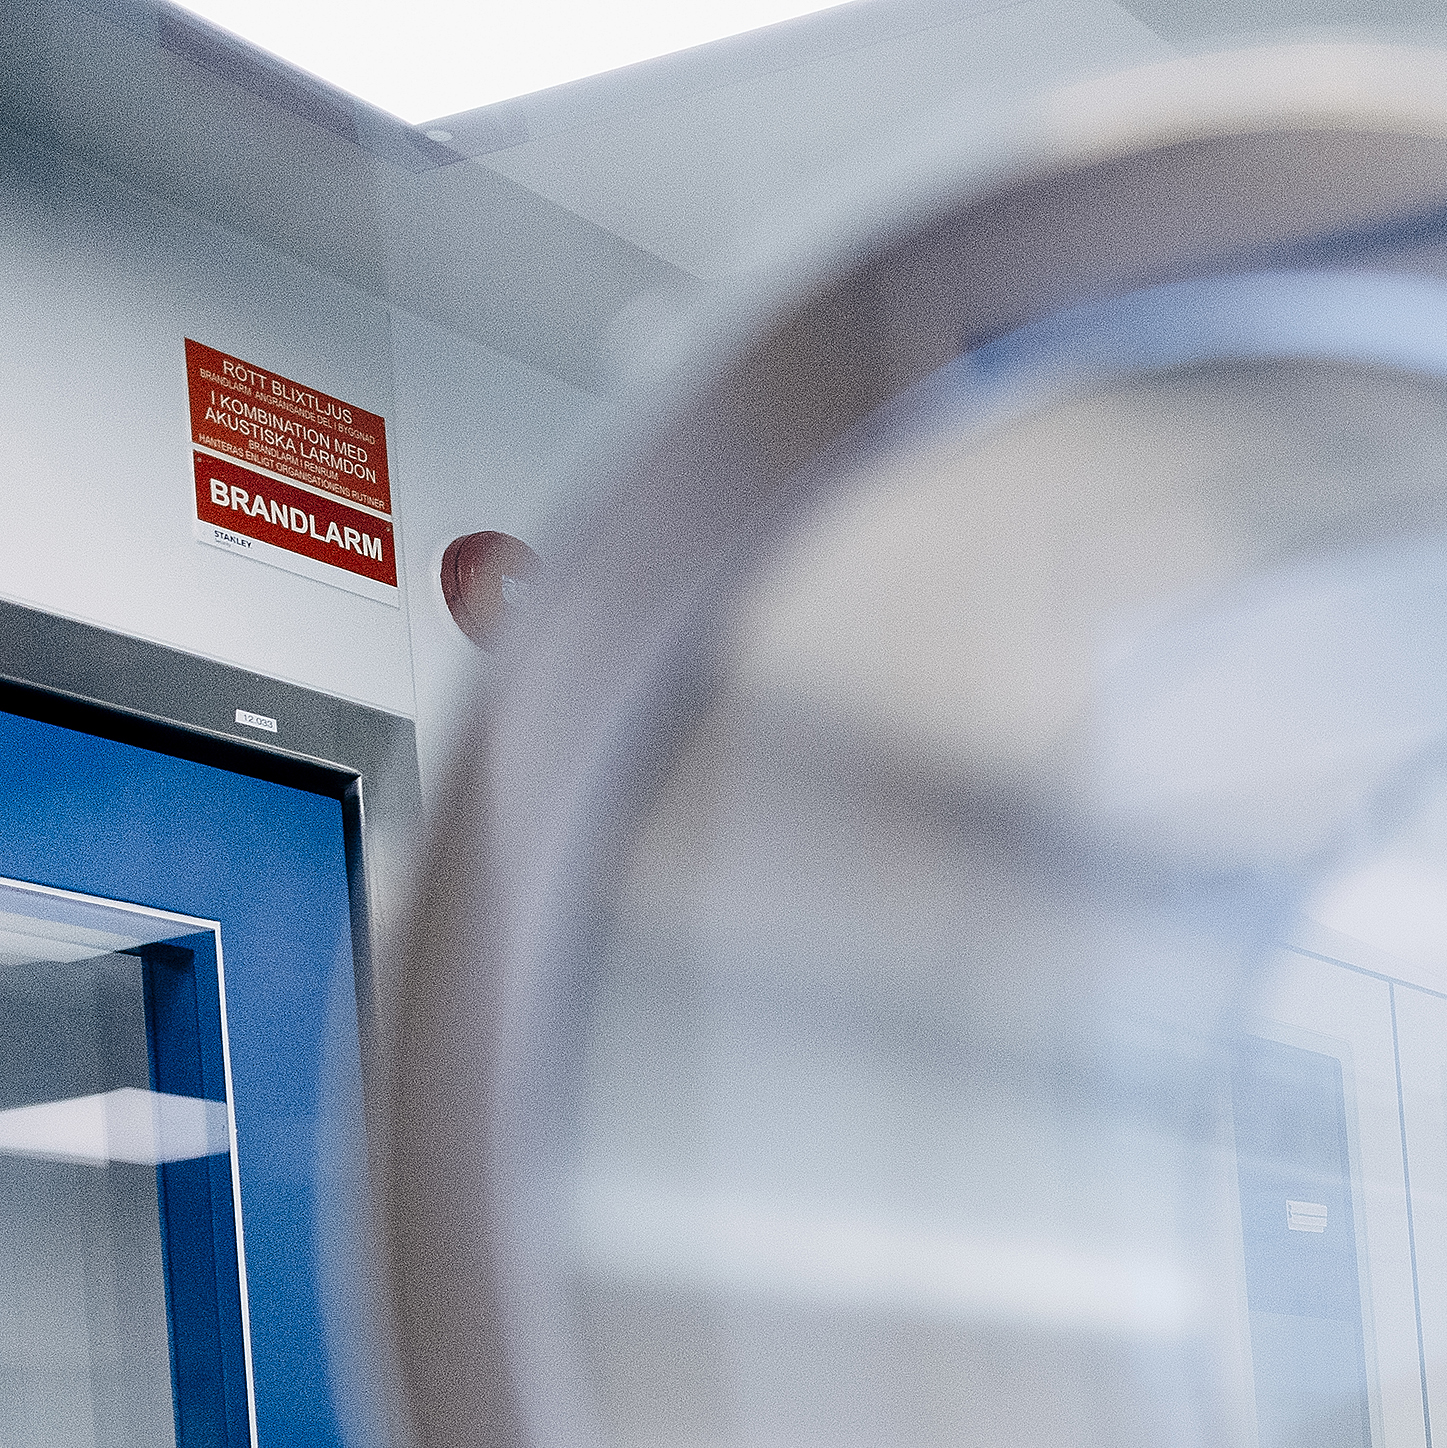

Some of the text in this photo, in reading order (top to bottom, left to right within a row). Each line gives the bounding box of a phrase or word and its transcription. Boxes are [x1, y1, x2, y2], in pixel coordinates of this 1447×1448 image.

[200, 368, 252, 396] BRANDLARM
[317, 414, 333, 429] DEL
[338, 423, 375, 445] BYGGNAD
[211, 390, 368, 463] I KOMBINATION MED
[223, 361, 353, 424] RÖTT BLIXTLJUS
[199, 433, 385, 509] HANTERAS ENLIGT ORGANISATIONENS RUTINER
[205, 407, 376, 484] AKUSTISKA LARMDON
[248, 440, 299, 466] BRANDLARM
[304, 460, 339, 481] RENRUM
[210, 477, 383, 562] BRANDLARM
[214, 530, 252, 549] STANLEY
